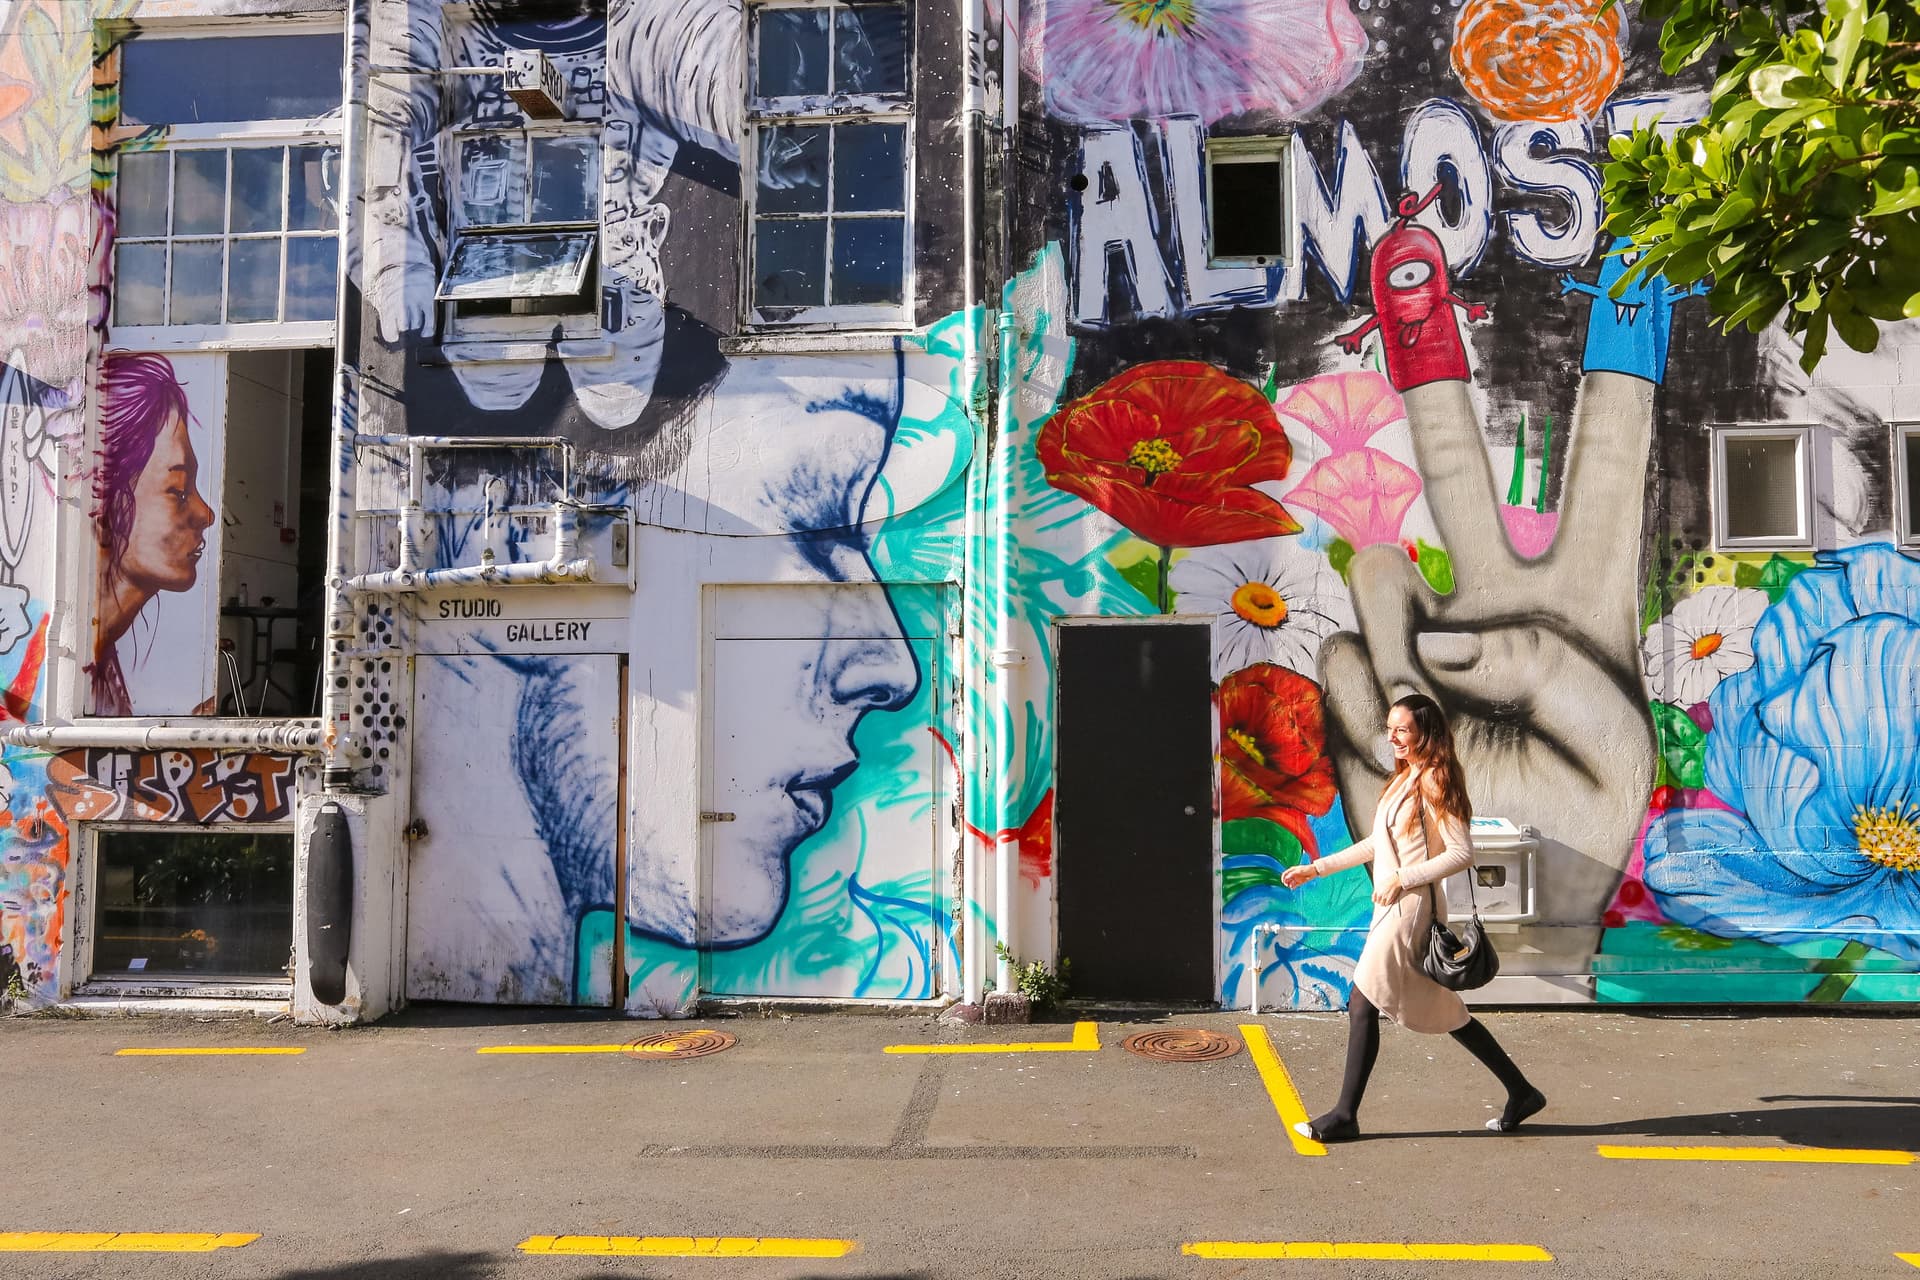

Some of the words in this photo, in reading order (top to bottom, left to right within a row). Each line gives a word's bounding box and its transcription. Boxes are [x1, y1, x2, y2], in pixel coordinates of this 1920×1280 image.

[11, 406, 20, 429] BE
[439, 598, 502, 618] STUDIO
[507, 622, 591, 642] GALLERY
[45, 749, 293, 822] SUSPECT
